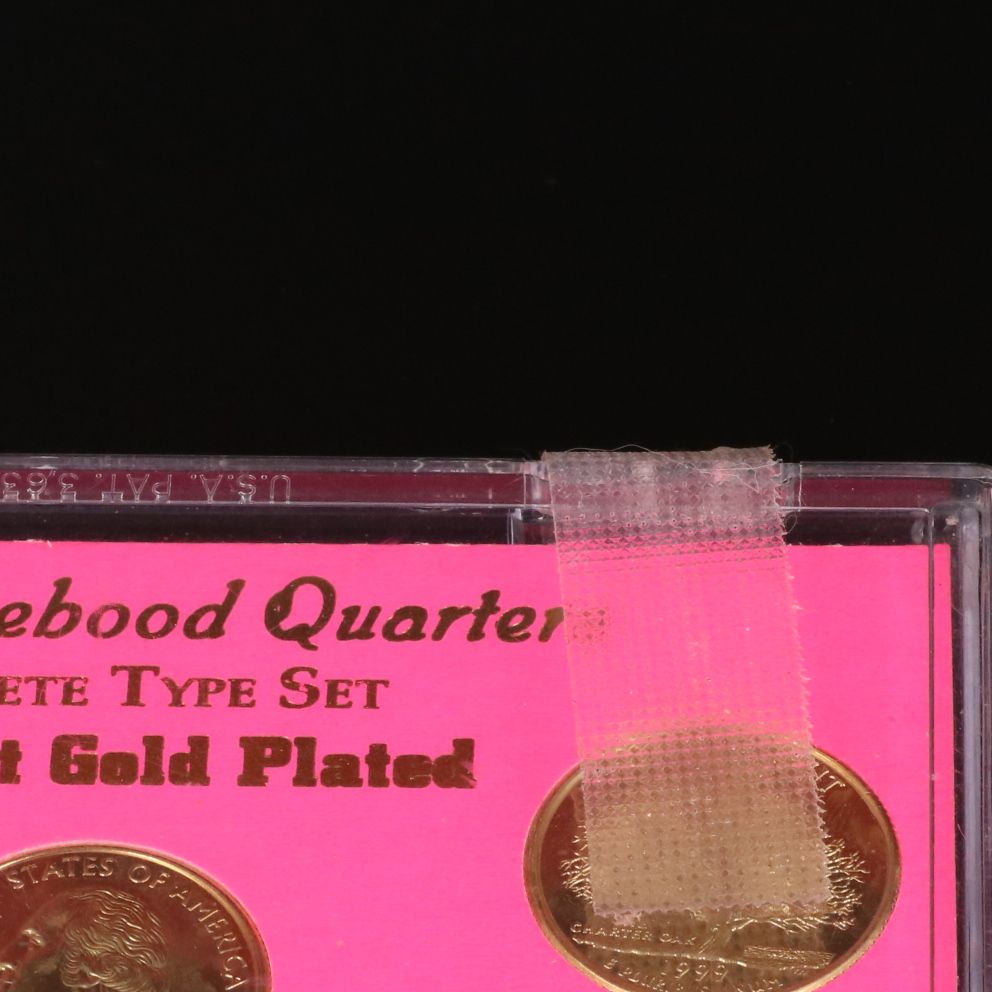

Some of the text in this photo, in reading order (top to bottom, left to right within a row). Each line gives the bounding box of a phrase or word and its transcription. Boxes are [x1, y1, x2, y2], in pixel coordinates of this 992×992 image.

[95, 473, 172, 503] PAT.
[264, 576, 570, 650] Quarter
[111, 665, 256, 708] TYPE
[279, 666, 390, 709] SET
[50, 733, 211, 787] Gold
[237, 736, 478, 789] Plated
[6, 855, 115, 892] STATES
[127, 862, 173, 889] OF
[168, 885, 249, 992] AMERICA
